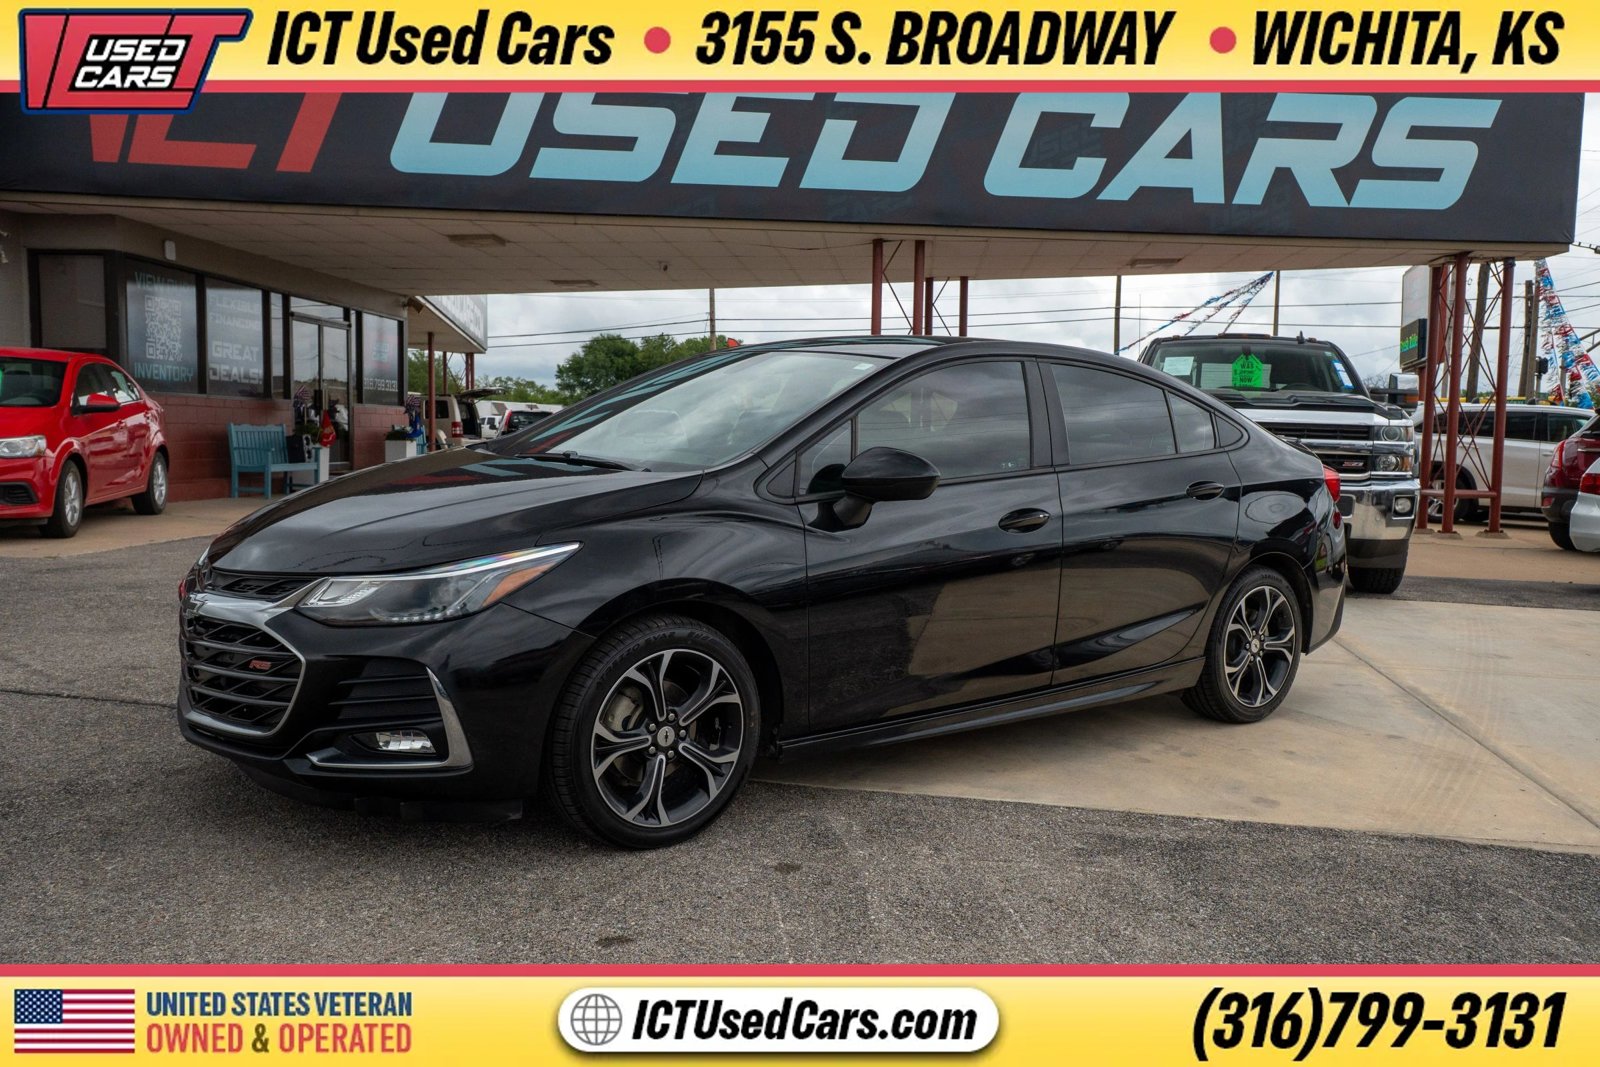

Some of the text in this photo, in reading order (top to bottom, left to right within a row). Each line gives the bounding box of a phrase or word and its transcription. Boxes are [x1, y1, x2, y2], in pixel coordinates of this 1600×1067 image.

[390, 92, 956, 192] USED
[984, 92, 1502, 211] CARS
[212, 340, 259, 362] GREAT
[134, 362, 194, 382] INVENTORY
[248, 660, 272, 670] RS
